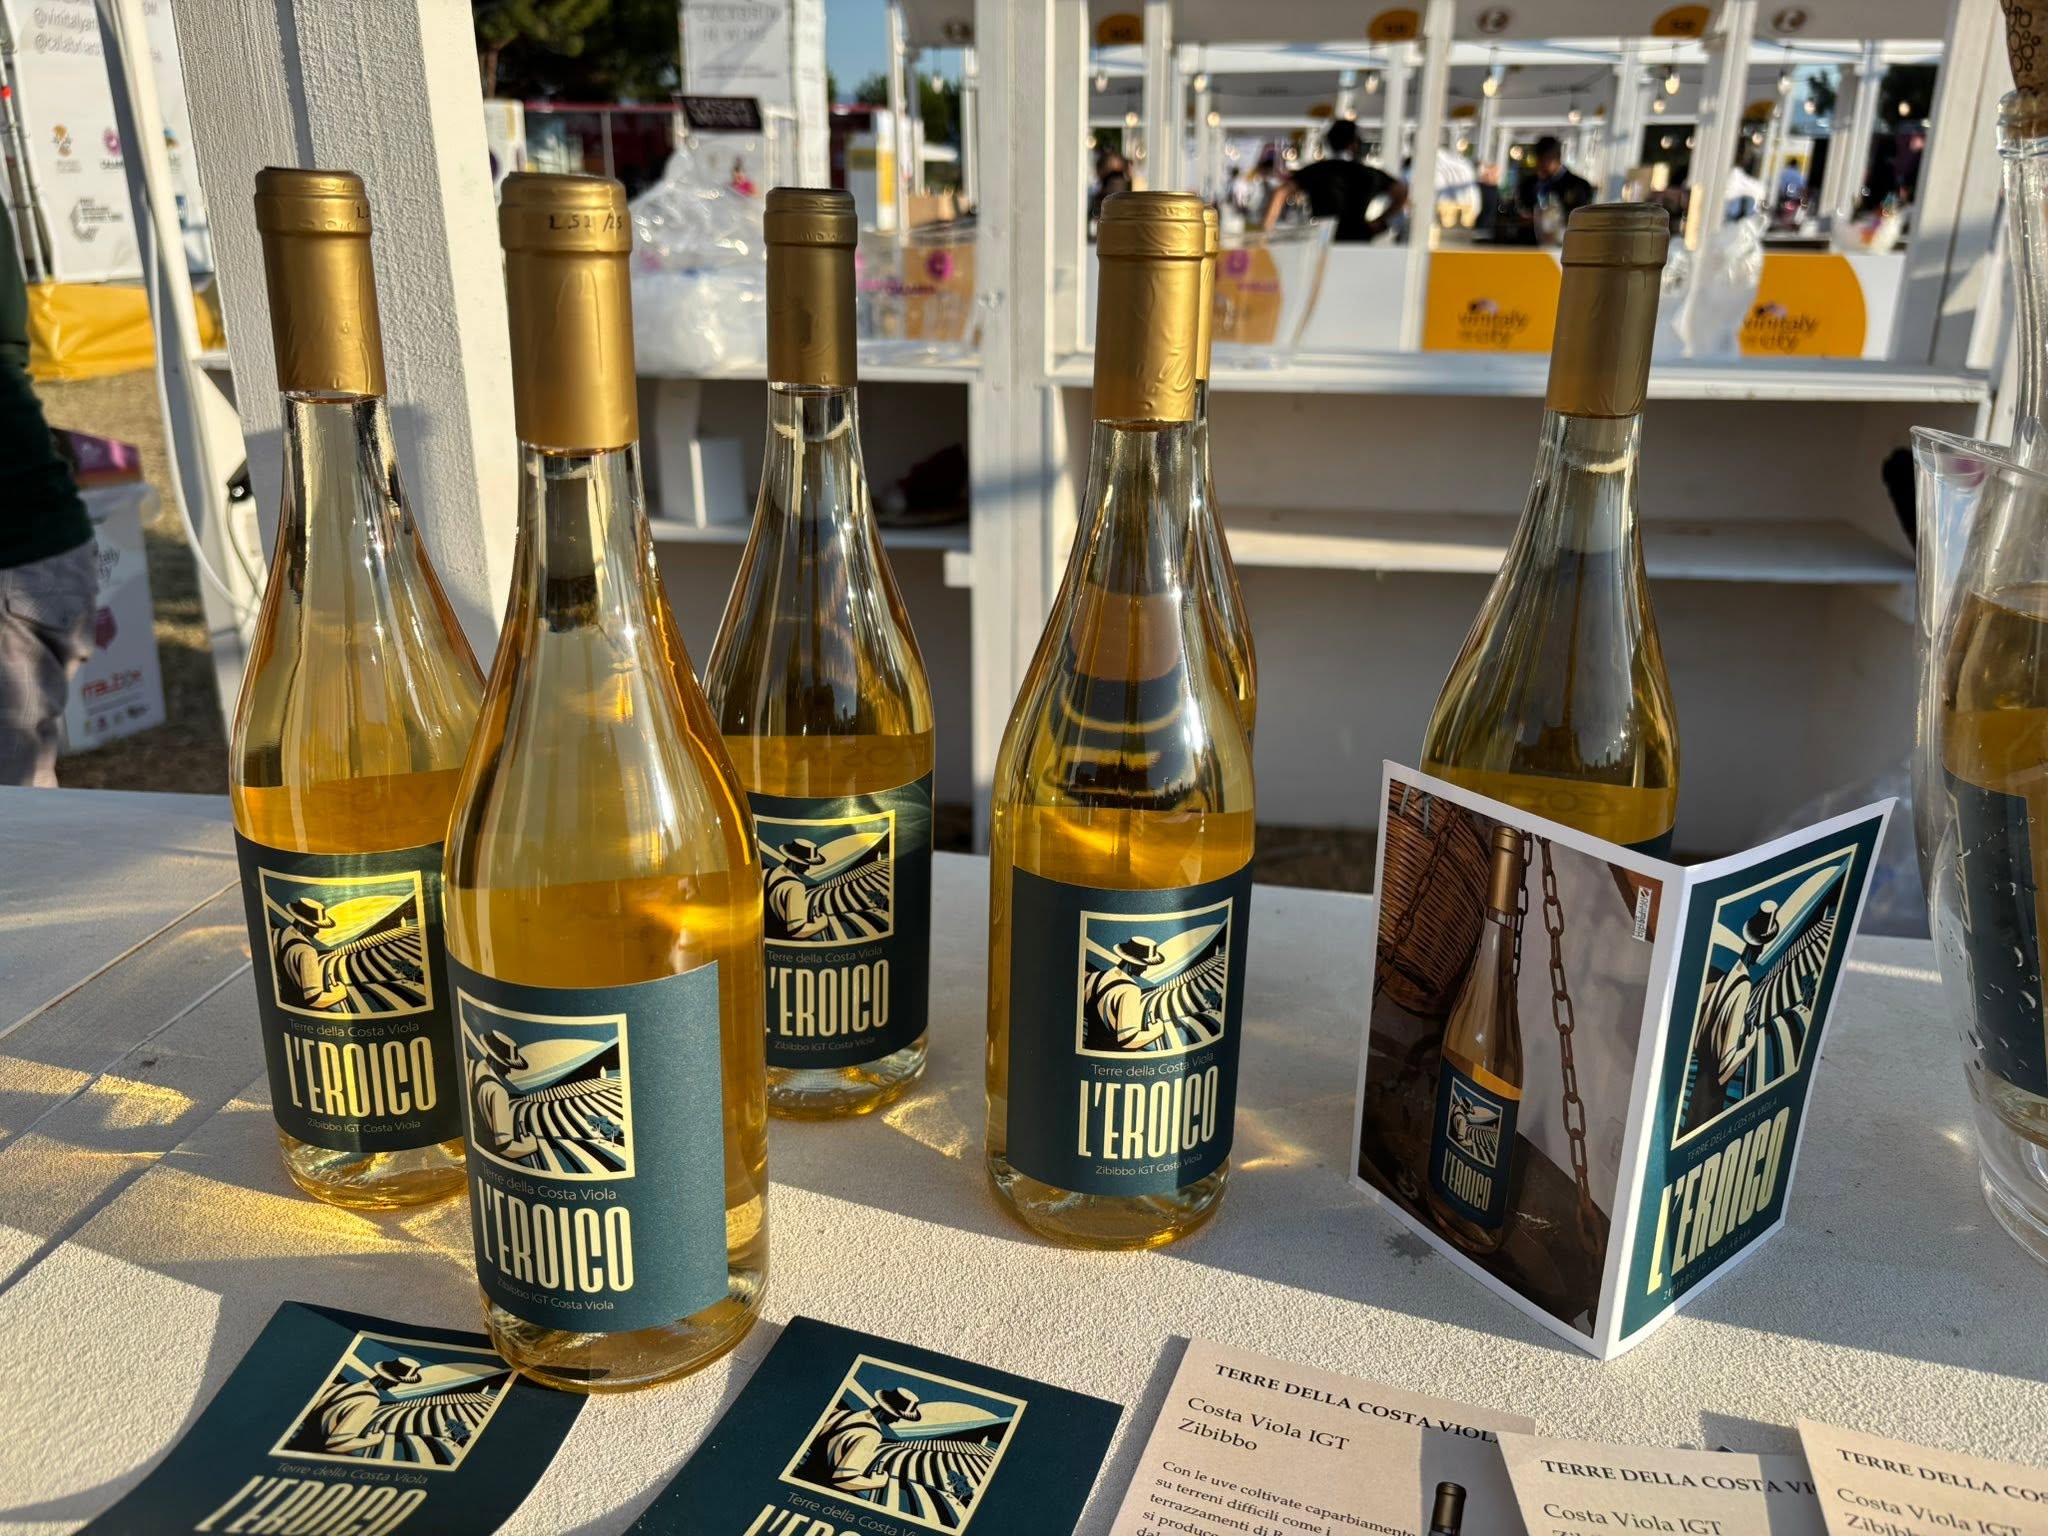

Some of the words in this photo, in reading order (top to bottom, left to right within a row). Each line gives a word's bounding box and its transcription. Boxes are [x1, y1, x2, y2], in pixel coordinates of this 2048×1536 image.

[767, 950, 793, 961] Terre
[796, 952, 822, 963] della
[825, 952, 856, 962] Costa
[858, 946, 882, 959] Viola
[288, 1018, 314, 1034] Terre
[316, 1024, 345, 1037] della
[347, 1026, 385, 1037] Costa
[387, 1021, 420, 1033] Viola
[828, 1041, 853, 1050] Costa
[283, 1032, 437, 1117] L'EROICO
[1091, 1063, 1122, 1077] Terre
[1126, 1065, 1155, 1077] della
[1158, 1061, 1189, 1075] Costa
[1191, 1051, 1214, 1067] Viola
[307, 1117, 342, 1131] Zibibbo
[344, 1123, 360, 1132] IGT
[363, 1124, 393, 1133] Costa
[394, 1120, 421, 1131] Viola
[1078, 1065, 1218, 1159] L'EROICO
[482, 1161, 505, 1185] Terre
[506, 1177, 535, 1195] della
[537, 1184, 577, 1201] Costa
[580, 1187, 617, 1201] Viola
[1096, 1166, 1136, 1176] Zibibbo
[1138, 1165, 1154, 1175] IGT
[1156, 1161, 1181, 1173] Costa
[1442, 1148, 1492, 1211] L'EROICO
[1646, 1106, 1790, 1296] L'EROICO
[476, 1175, 635, 1294] L'EROICO
[531, 1292, 549, 1305] IGT
[551, 1297, 582, 1310] Costa
[585, 1300, 615, 1310] Viola
[1215, 1364, 1280, 1390] TERRE
[1284, 1382, 1352, 1409] DELLA
[1357, 1402, 1432, 1428] COSTA
[1178, 1417, 1257, 1451] Zibibbo
[1187, 1397, 1243, 1423] Costa
[1250, 1413, 1302, 1439] Viola
[1308, 1429, 1350, 1450] IGT
[277, 1462, 312, 1474] Terre
[313, 1465, 347, 1478] della
[350, 1468, 390, 1481] Costa
[394, 1472, 428, 1484] Viola
[1162, 1461, 1191, 1477] Con
[1194, 1470, 1207, 1482] le
[1211, 1477, 1237, 1490] uve
[1240, 1487, 1302, 1510] coltivate
[1540, 1460, 1616, 1480] TERRE
[1620, 1468, 1698, 1488] DELLA
[1701, 1475, 1783, 1493] COSTA
[1836, 1449, 1914, 1476] TERRE
[1918, 1467, 1998, 1495] DELLA
[194, 1475, 428, 1536] L'EROICO
[787, 1491, 819, 1512] Terre
[822, 1504, 855, 1523] della
[858, 1515, 898, 1536] Costa
[1142, 1511, 1154, 1521] si
[1150, 1493, 1250, 1532] terrazzamenti
[1253, 1525, 1269, 1536] di
[1155, 1478, 1172, 1489] su
[1176, 1484, 1224, 1505] terreni
[1227, 1499, 1279, 1522] difficili
[1282, 1517, 1322, 1534] come
[1543, 1503, 1608, 1525] Costa
[1611, 1511, 1675, 1532] Viola
[1678, 1518, 1721, 1536] IGT
[1837, 1487, 1902, 1515] Costa
[1906, 1504, 1971, 1532] Viola
[1975, 1520, 2022, 1536] IGT
